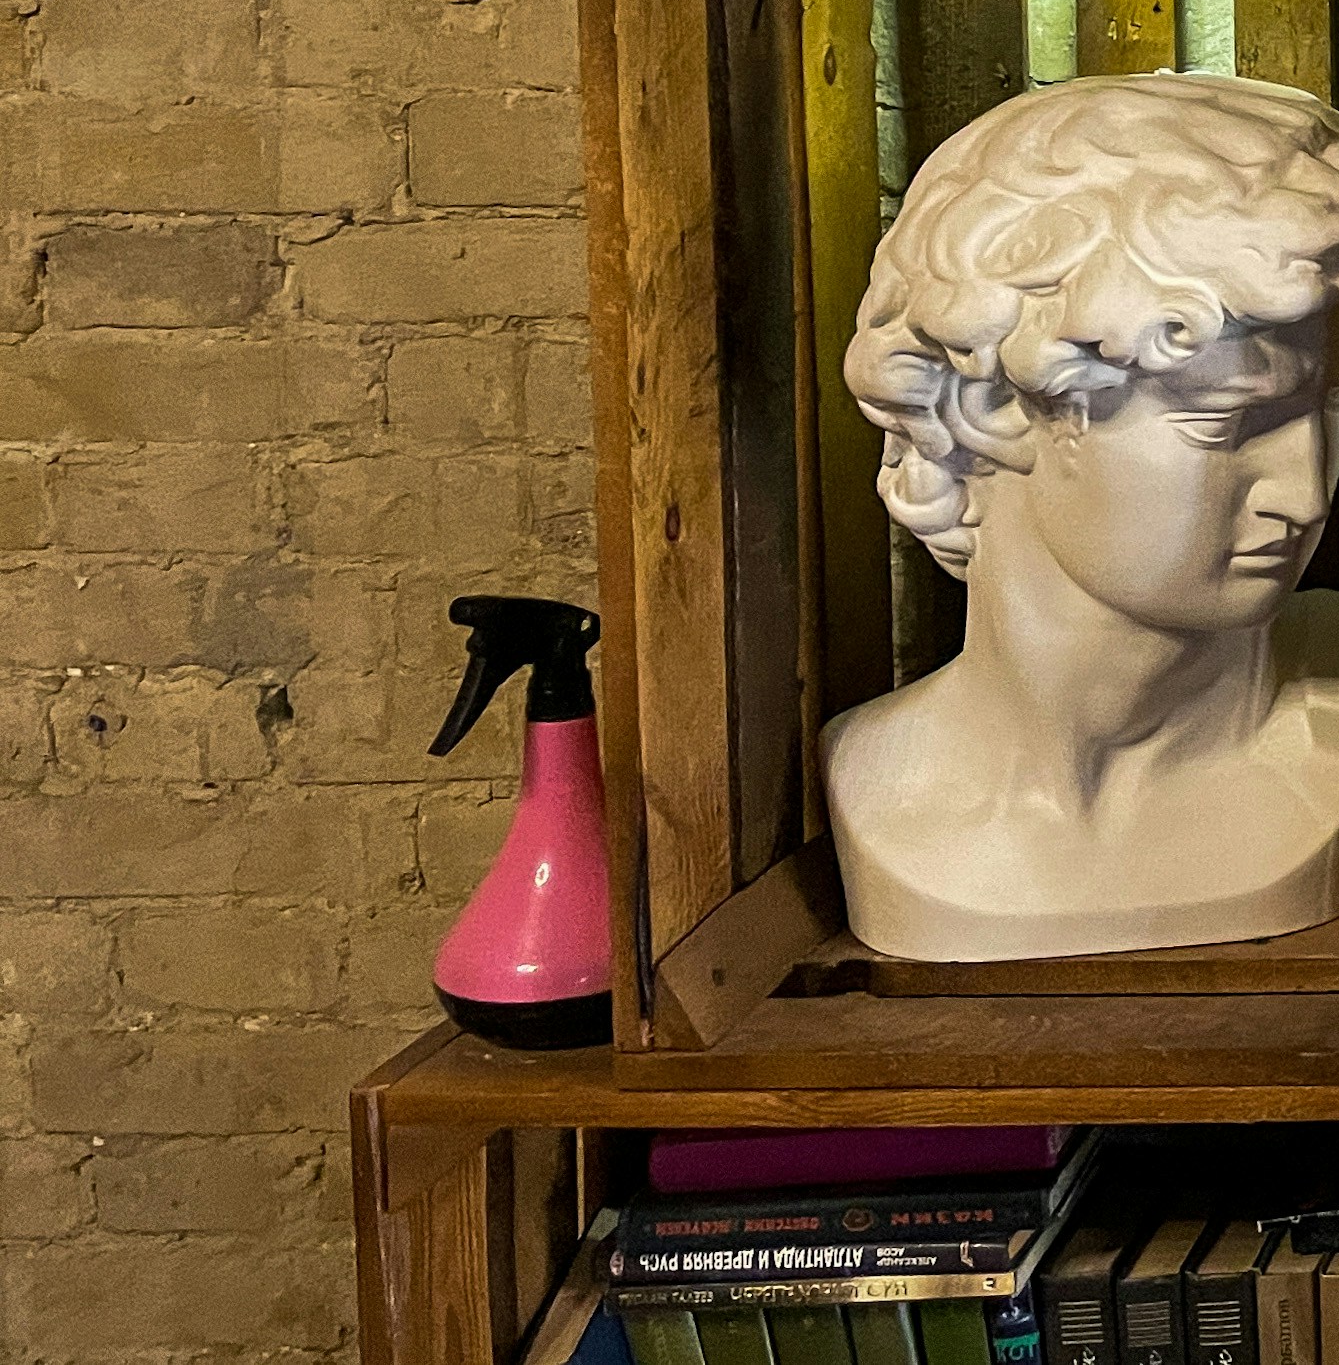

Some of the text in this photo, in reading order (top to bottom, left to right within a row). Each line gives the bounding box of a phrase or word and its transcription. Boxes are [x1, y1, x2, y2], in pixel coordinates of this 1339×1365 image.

[639, 1246, 864, 1273] АТЛАНТИДА И ДРЕВНЯЯ РУСЬ
